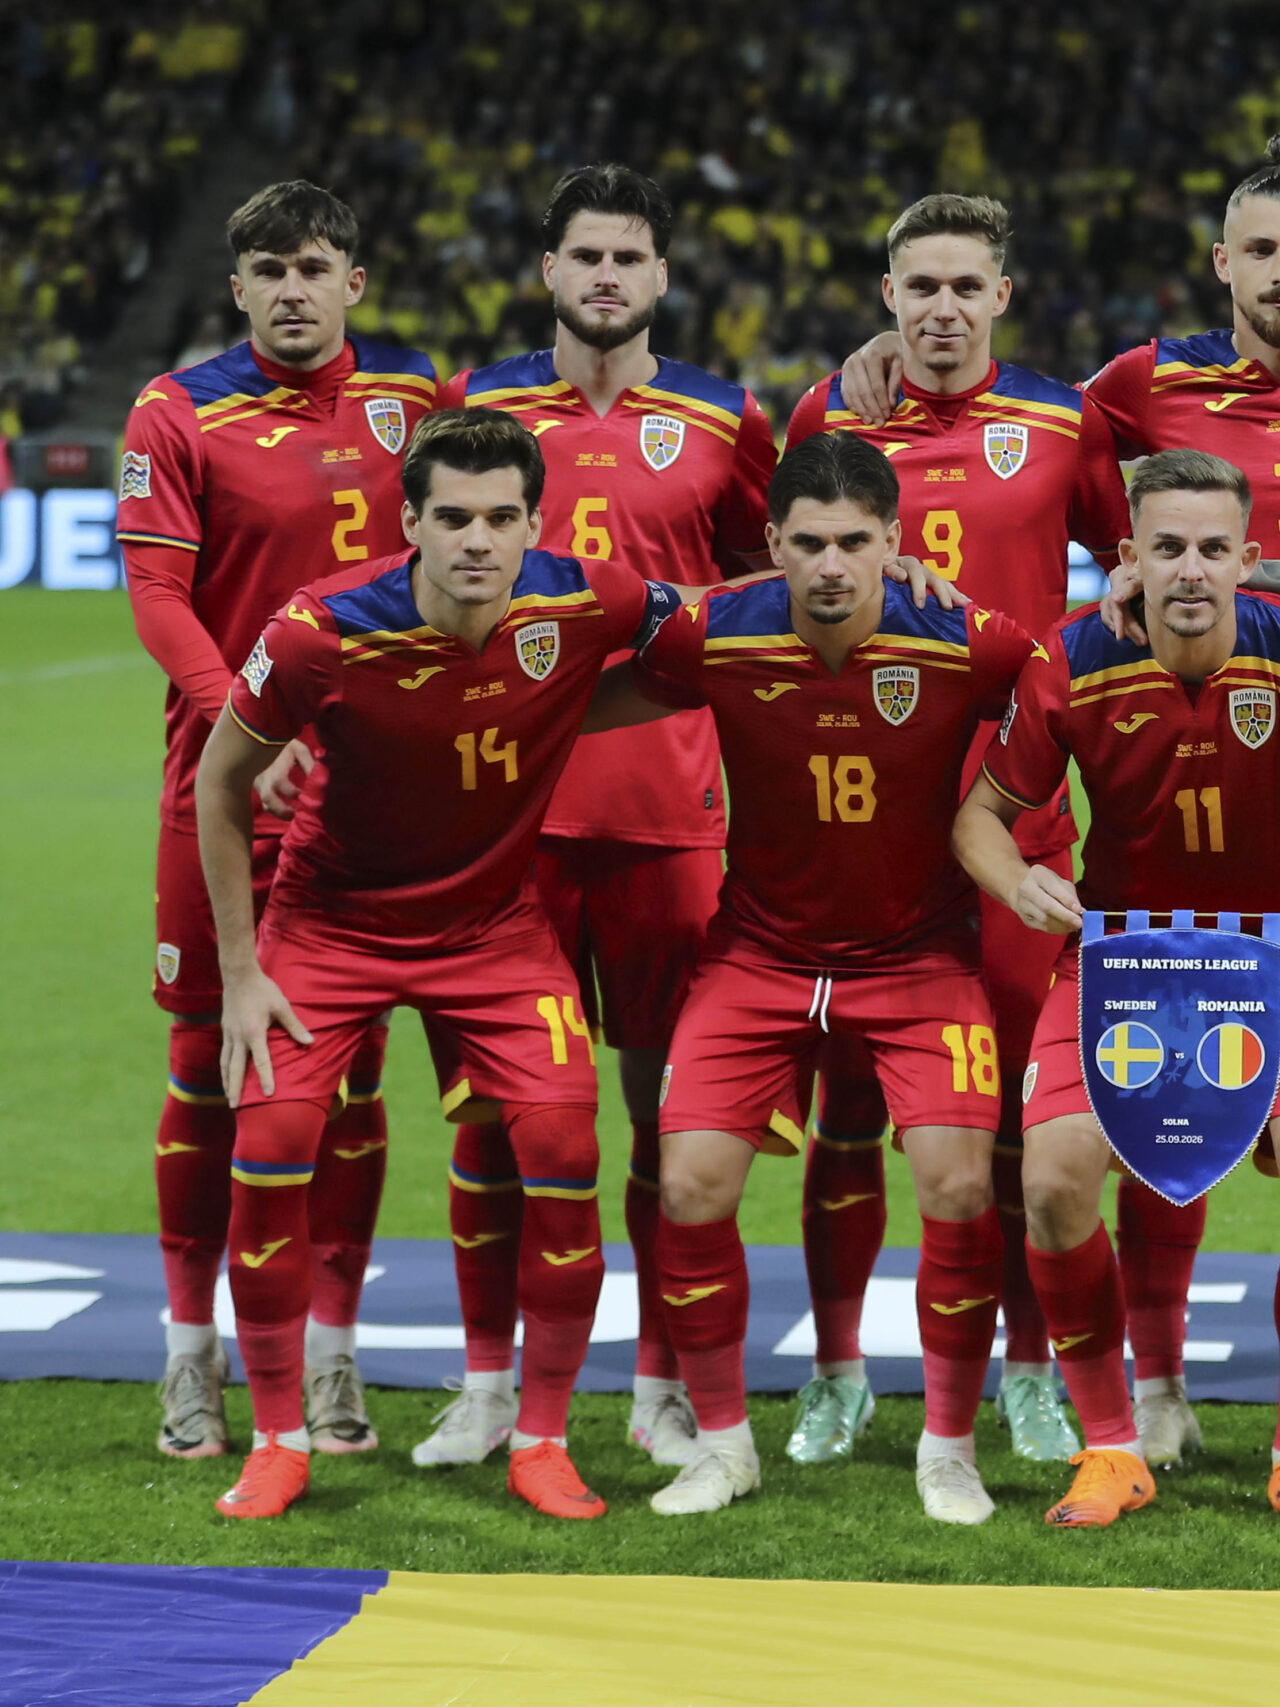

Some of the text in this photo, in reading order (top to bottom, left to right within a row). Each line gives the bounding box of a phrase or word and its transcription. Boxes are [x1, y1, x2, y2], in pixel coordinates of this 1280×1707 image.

[646, 418, 680, 431] ROMÂNIA
[988, 425, 1024, 437] ROMÂNIA
[331, 489, 369, 561] 2
[571, 497, 613, 561] 6
[921, 510, 963, 581] 9
[519, 625, 554, 641] ROMÂNIA
[877, 668, 915, 680] ROMÂNIA
[1233, 690, 1271, 703] ROMÂNIA
[454, 727, 519, 790] 14
[808, 755, 877, 823] 18
[1174, 786, 1225, 852] 11
[1103, 958, 1258, 970] UEFA NATIONS LEAGUE
[1104, 1000, 1157, 1011] SWEDEN
[1197, 1000, 1266, 1012] ROMANIA
[536, 995, 596, 1067] 14
[941, 1024, 999, 1097] 18
[1162, 1118, 1190, 1126] SOLNA
[1155, 1135, 1203, 1144] 25.09.2026
